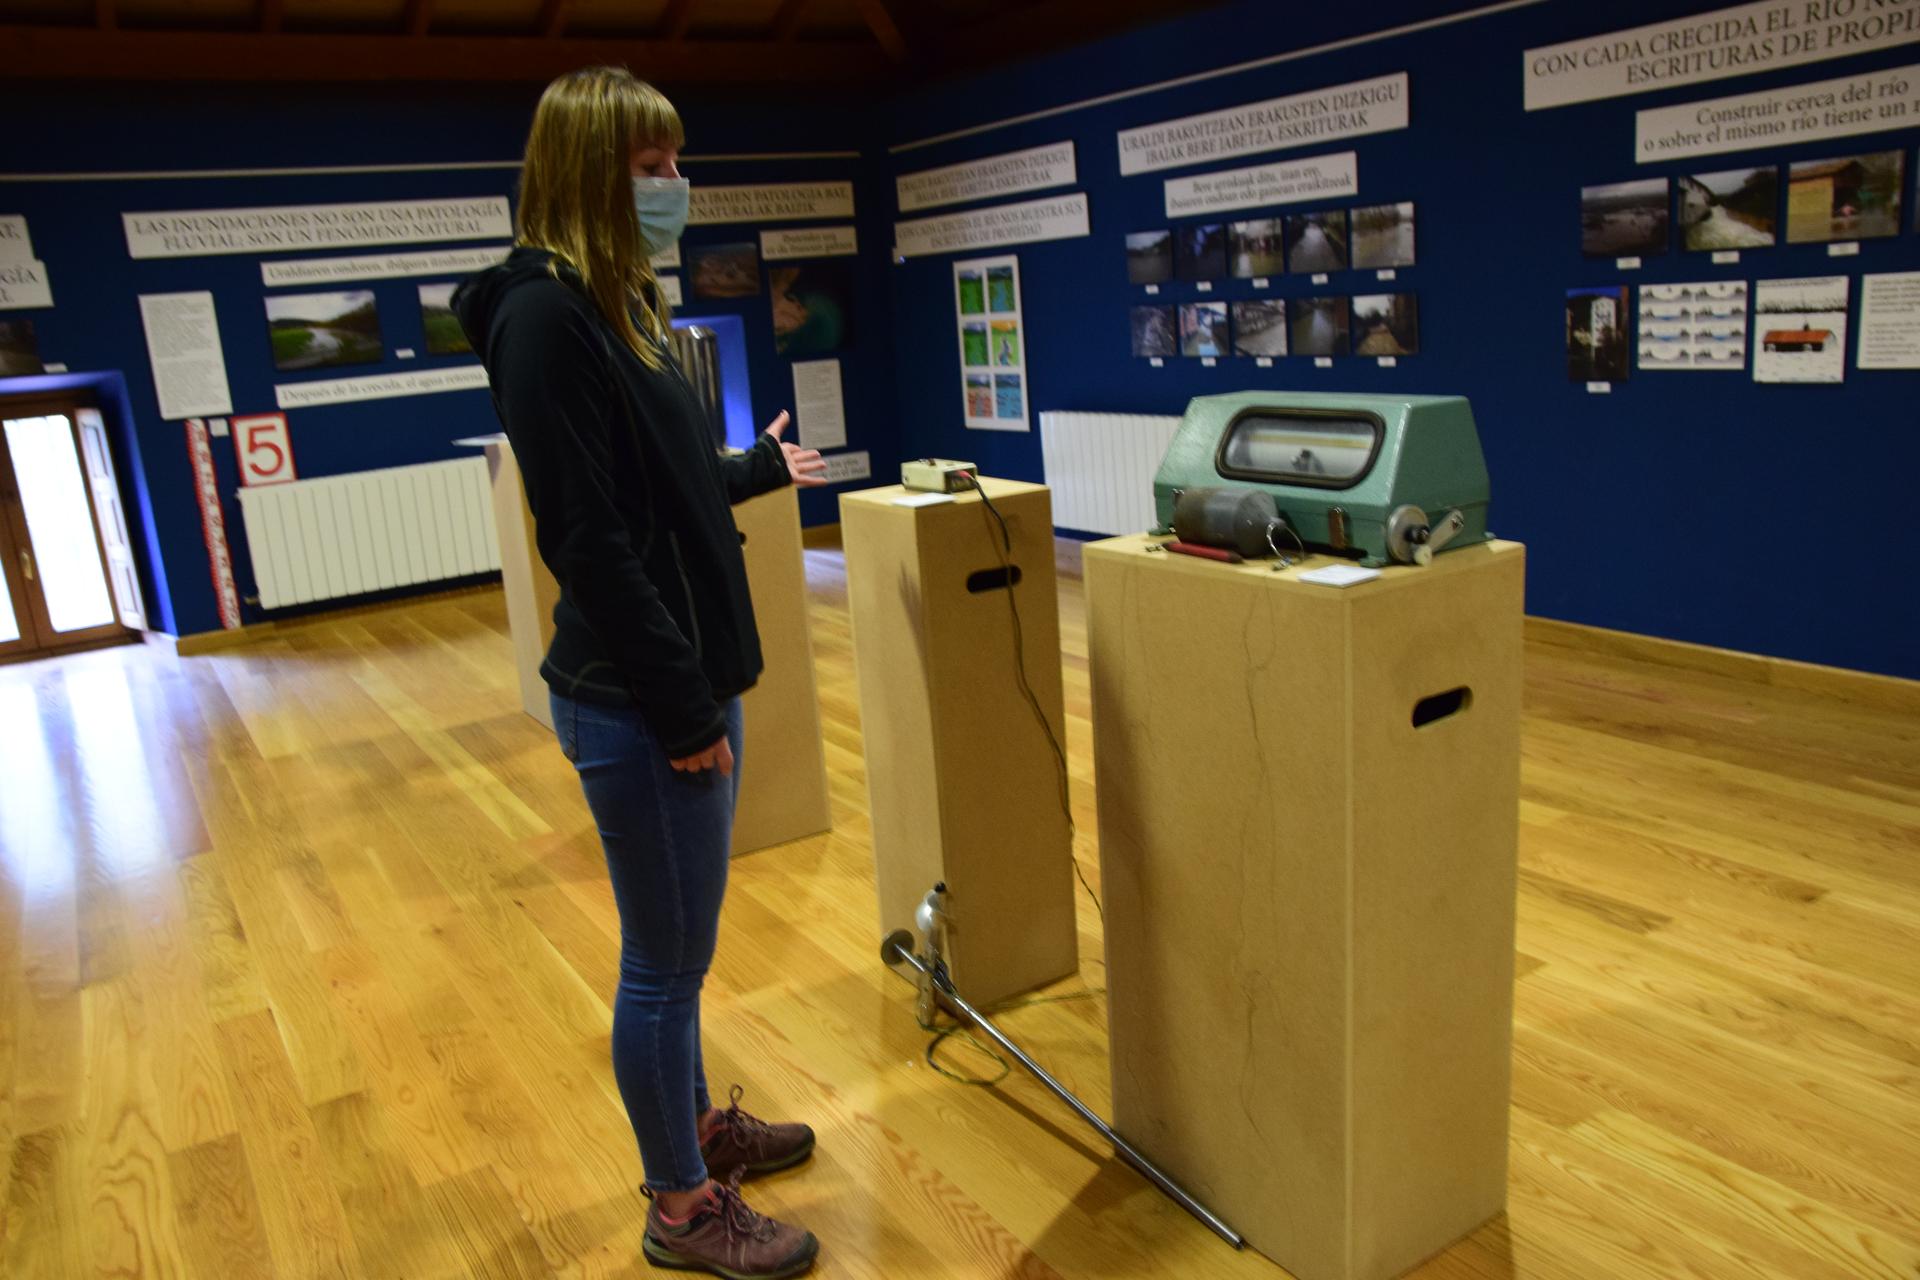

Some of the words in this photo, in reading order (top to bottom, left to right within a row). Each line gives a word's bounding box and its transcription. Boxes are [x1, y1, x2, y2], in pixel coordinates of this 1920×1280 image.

[1533, 52, 1578, 77] CON
[1584, 40, 1645, 68] CADA
[1650, 16, 1758, 55] CRECIDA
[1765, 7, 1797, 33] EL
[1627, 38, 1774, 84] ESCRITURAS
[1781, 29, 1818, 57] DE
[1168, 114, 1245, 143] BAKOITZEAN
[1248, 96, 1329, 127] ERAKUSTEN
[1332, 82, 1400, 112] DIZKIGU
[1696, 97, 1782, 125] Construir
[1786, 92, 1836, 113] cerca
[1841, 80, 1872, 103] del
[1878, 75, 1909, 97] río
[1644, 140, 1655, 151] o
[1658, 131, 1702, 150] sobre
[1706, 126, 1721, 143] el
[1725, 120, 1787, 141] mismo
[1791, 114, 1819, 132] río
[1823, 106, 1873, 127] tiene
[1879, 102, 1907, 118] un
[134, 218, 168, 234] LAS
[171, 213, 309, 234] INUNDACIONES
[313, 212, 338, 225] NO
[342, 211, 375, 224] SON
[380, 209, 414, 222] UNA
[248, 230, 282, 245] SON
[286, 228, 313, 243] UN
[414, 219, 482, 236] NATURAL
[334, 383, 346, 396] de
[350, 382, 360, 395] la
[407, 376, 417, 388] el
[418, 376, 443, 389] agua
[248, 424, 284, 477] 5
